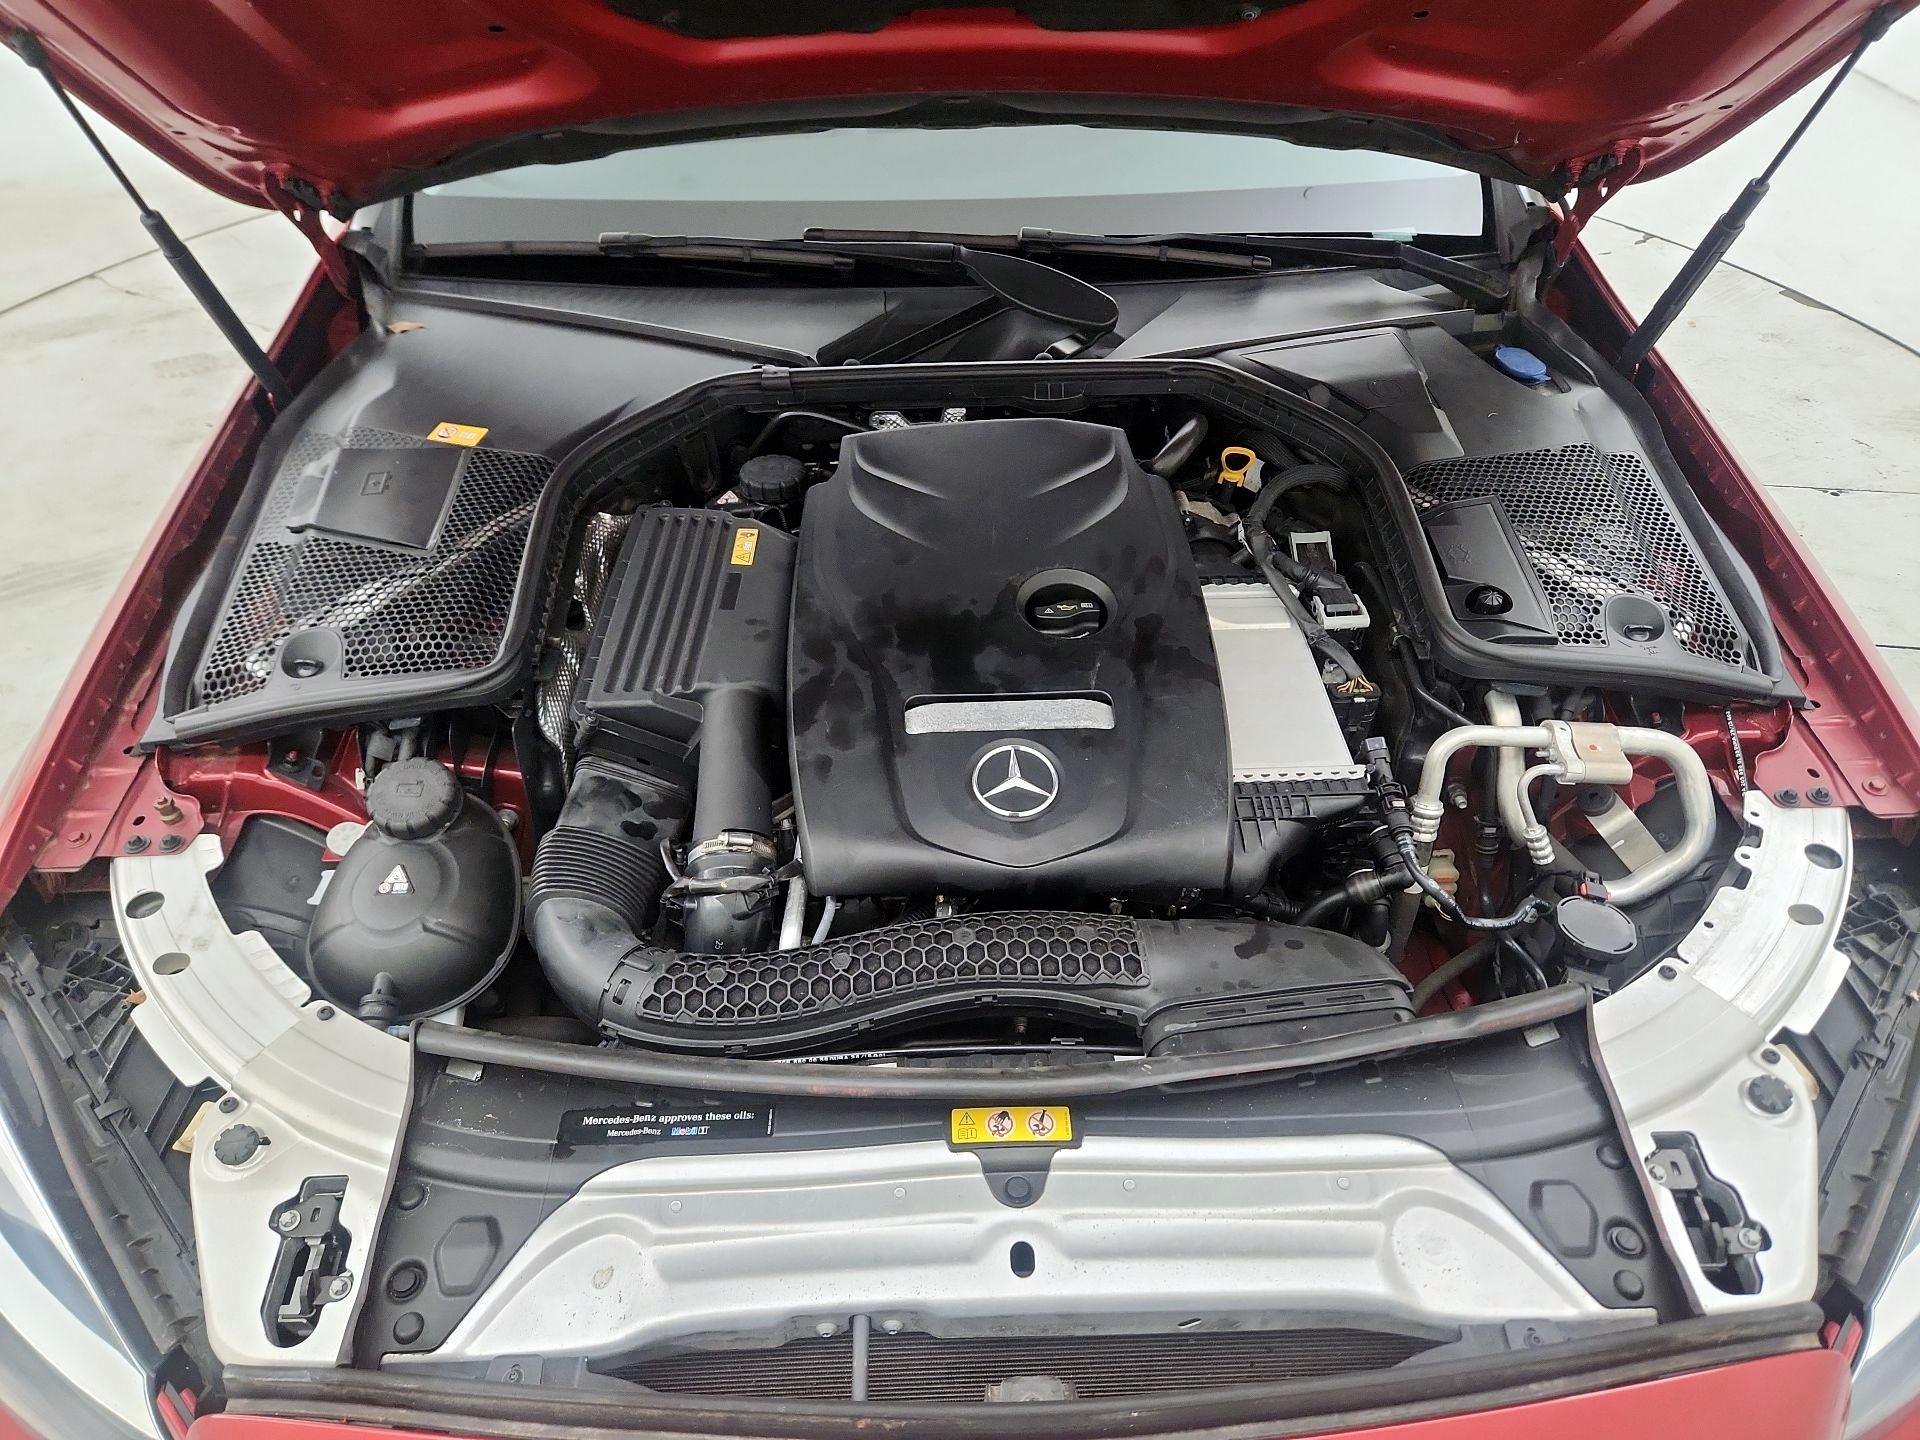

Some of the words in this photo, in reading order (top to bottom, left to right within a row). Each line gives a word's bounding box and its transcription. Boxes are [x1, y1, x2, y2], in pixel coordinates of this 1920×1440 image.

[582, 1114, 657, 1126] Mercedes-Benz
[658, 1113, 703, 1125] approves
[705, 1112, 732, 1121] these
[733, 1110, 756, 1121] oils:
[606, 1127, 662, 1137] Mercedes-Benz
[671, 1126, 697, 1136] Mobil
